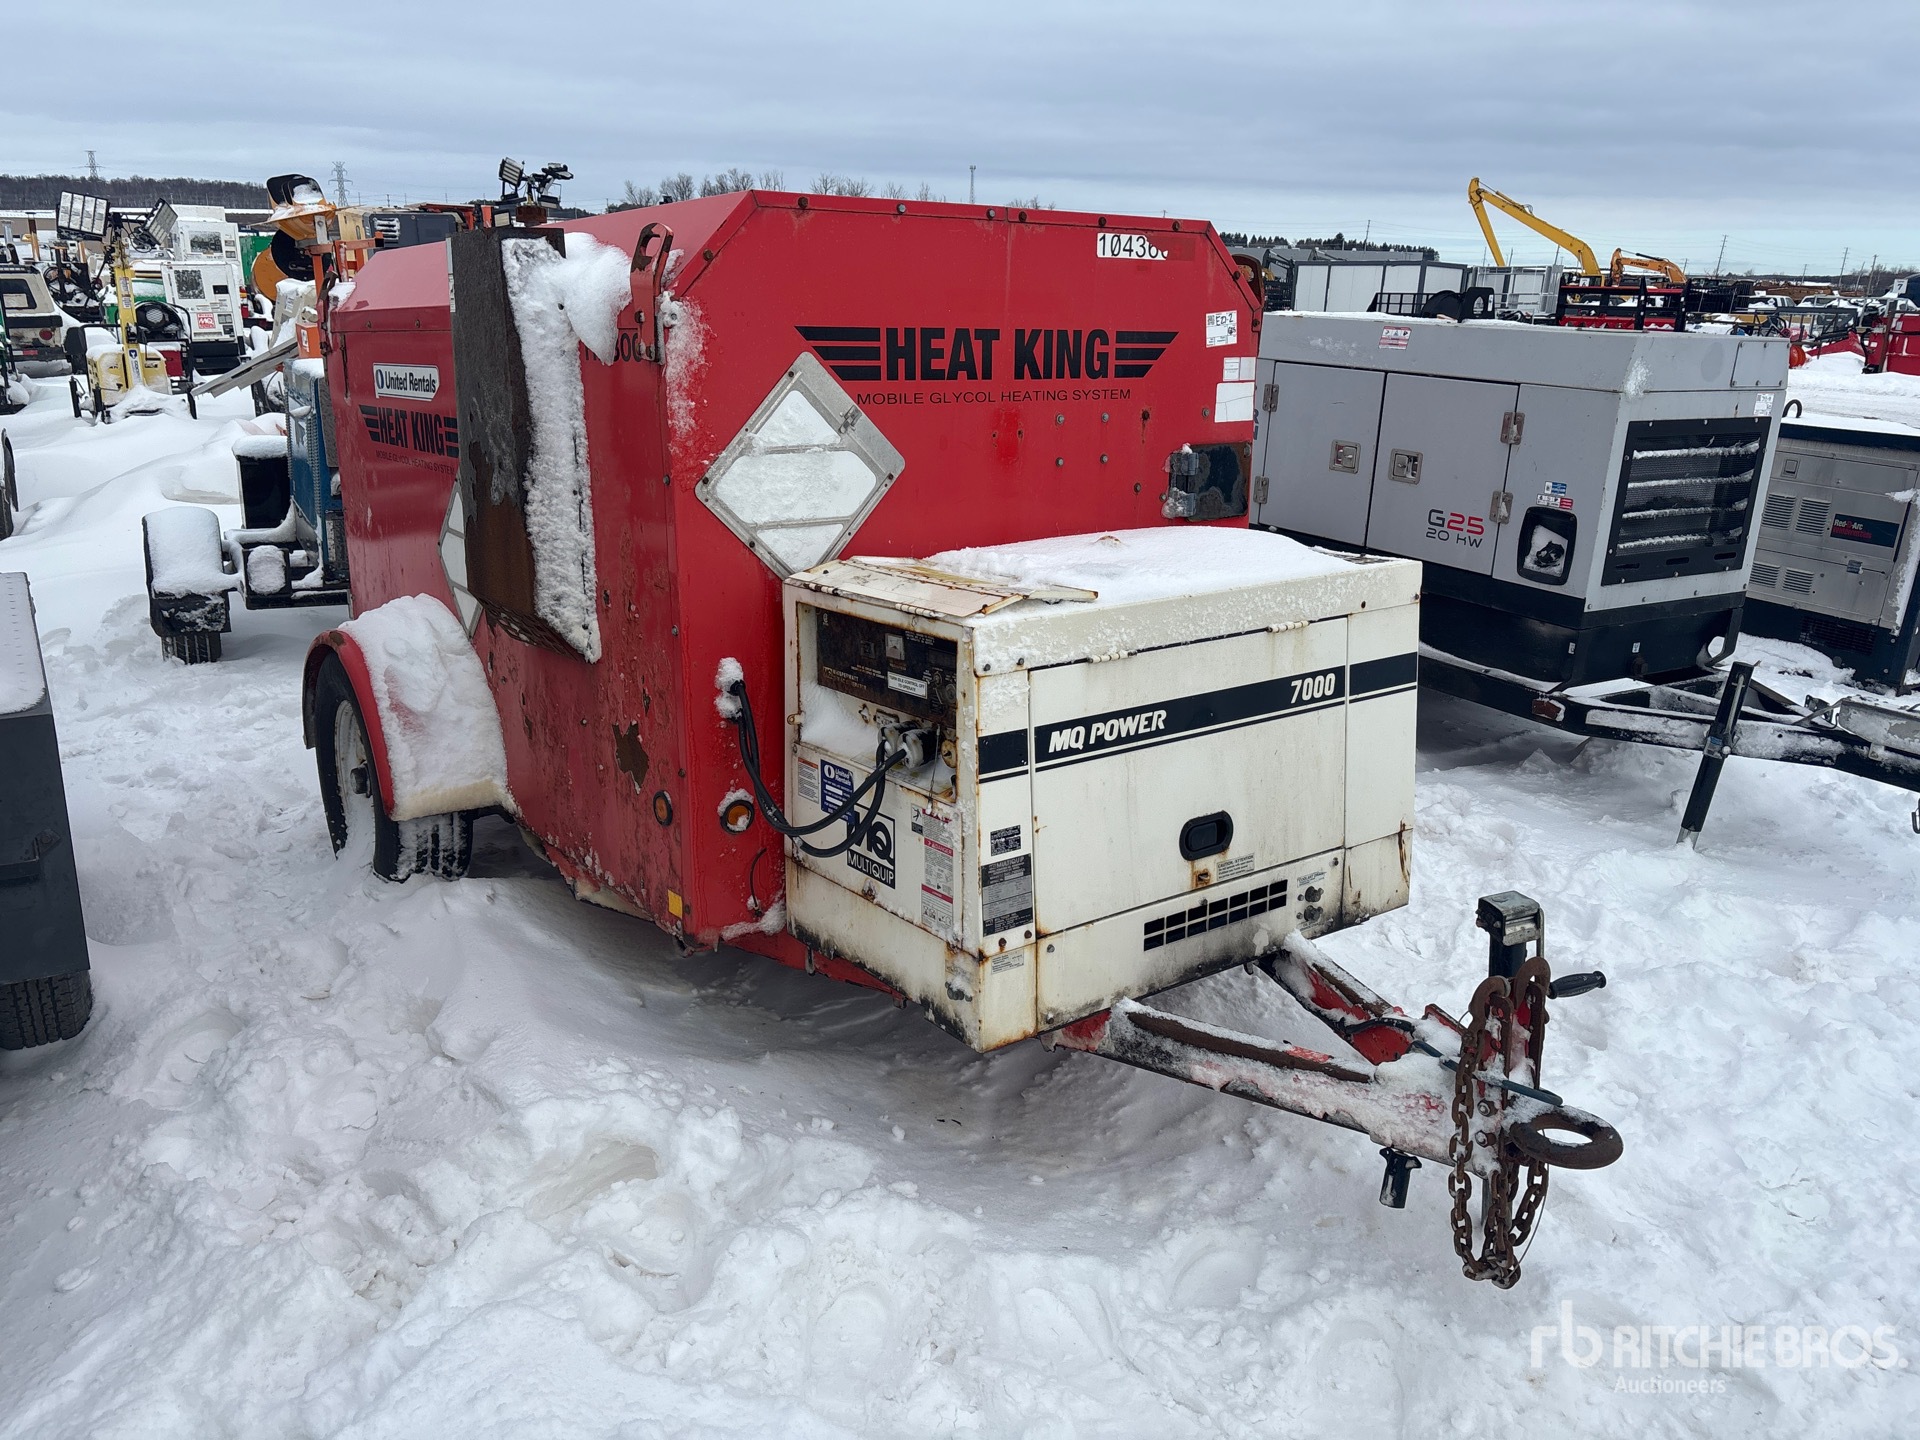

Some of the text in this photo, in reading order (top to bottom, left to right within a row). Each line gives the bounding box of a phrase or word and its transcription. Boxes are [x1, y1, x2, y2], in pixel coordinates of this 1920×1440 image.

[885, 327, 1110, 381] HEAT KING
[385, 371, 436, 393] United Rentals
[857, 388, 1131, 405] MOBILE GLYCOL HEATING SYSTEM
[378, 407, 445, 456] HEAT KING
[376, 450, 392, 461] MOBILE
[411, 458, 433, 471] HEATING
[433, 462, 455, 475] SYSTEM
[1426, 527, 1450, 541] 20
[1428, 509, 1484, 535] G25
[1290, 672, 1336, 703] 7000
[1048, 709, 1167, 752] MQ POWER
[848, 850, 895, 884] MULTIQUIP
